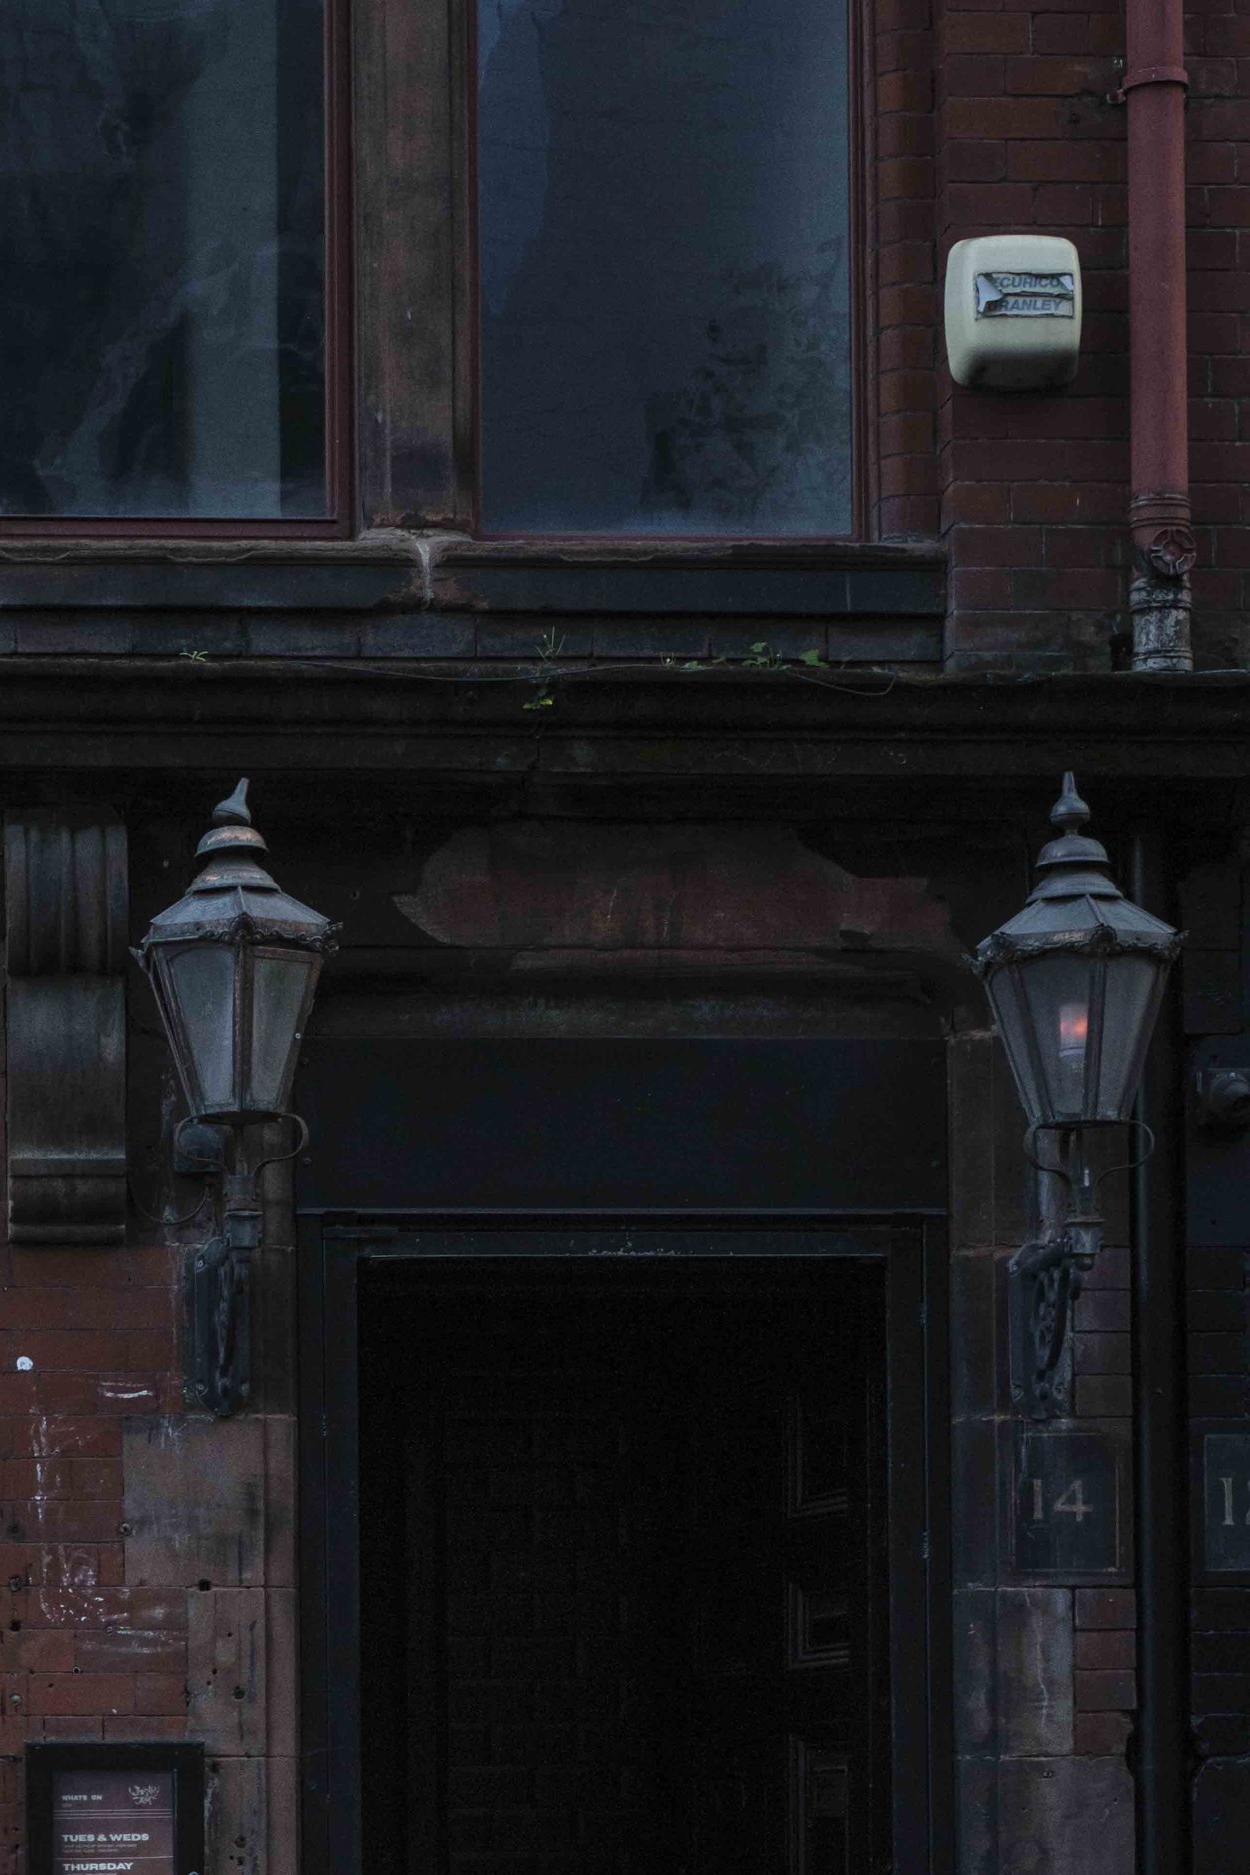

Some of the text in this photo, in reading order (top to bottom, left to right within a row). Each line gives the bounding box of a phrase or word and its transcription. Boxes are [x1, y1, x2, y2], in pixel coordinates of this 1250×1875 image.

[1033, 1479, 1094, 1522] 14
[62, 1833, 149, 1843] TUES & WEDS
[63, 1862, 134, 1871] THURSDAY
